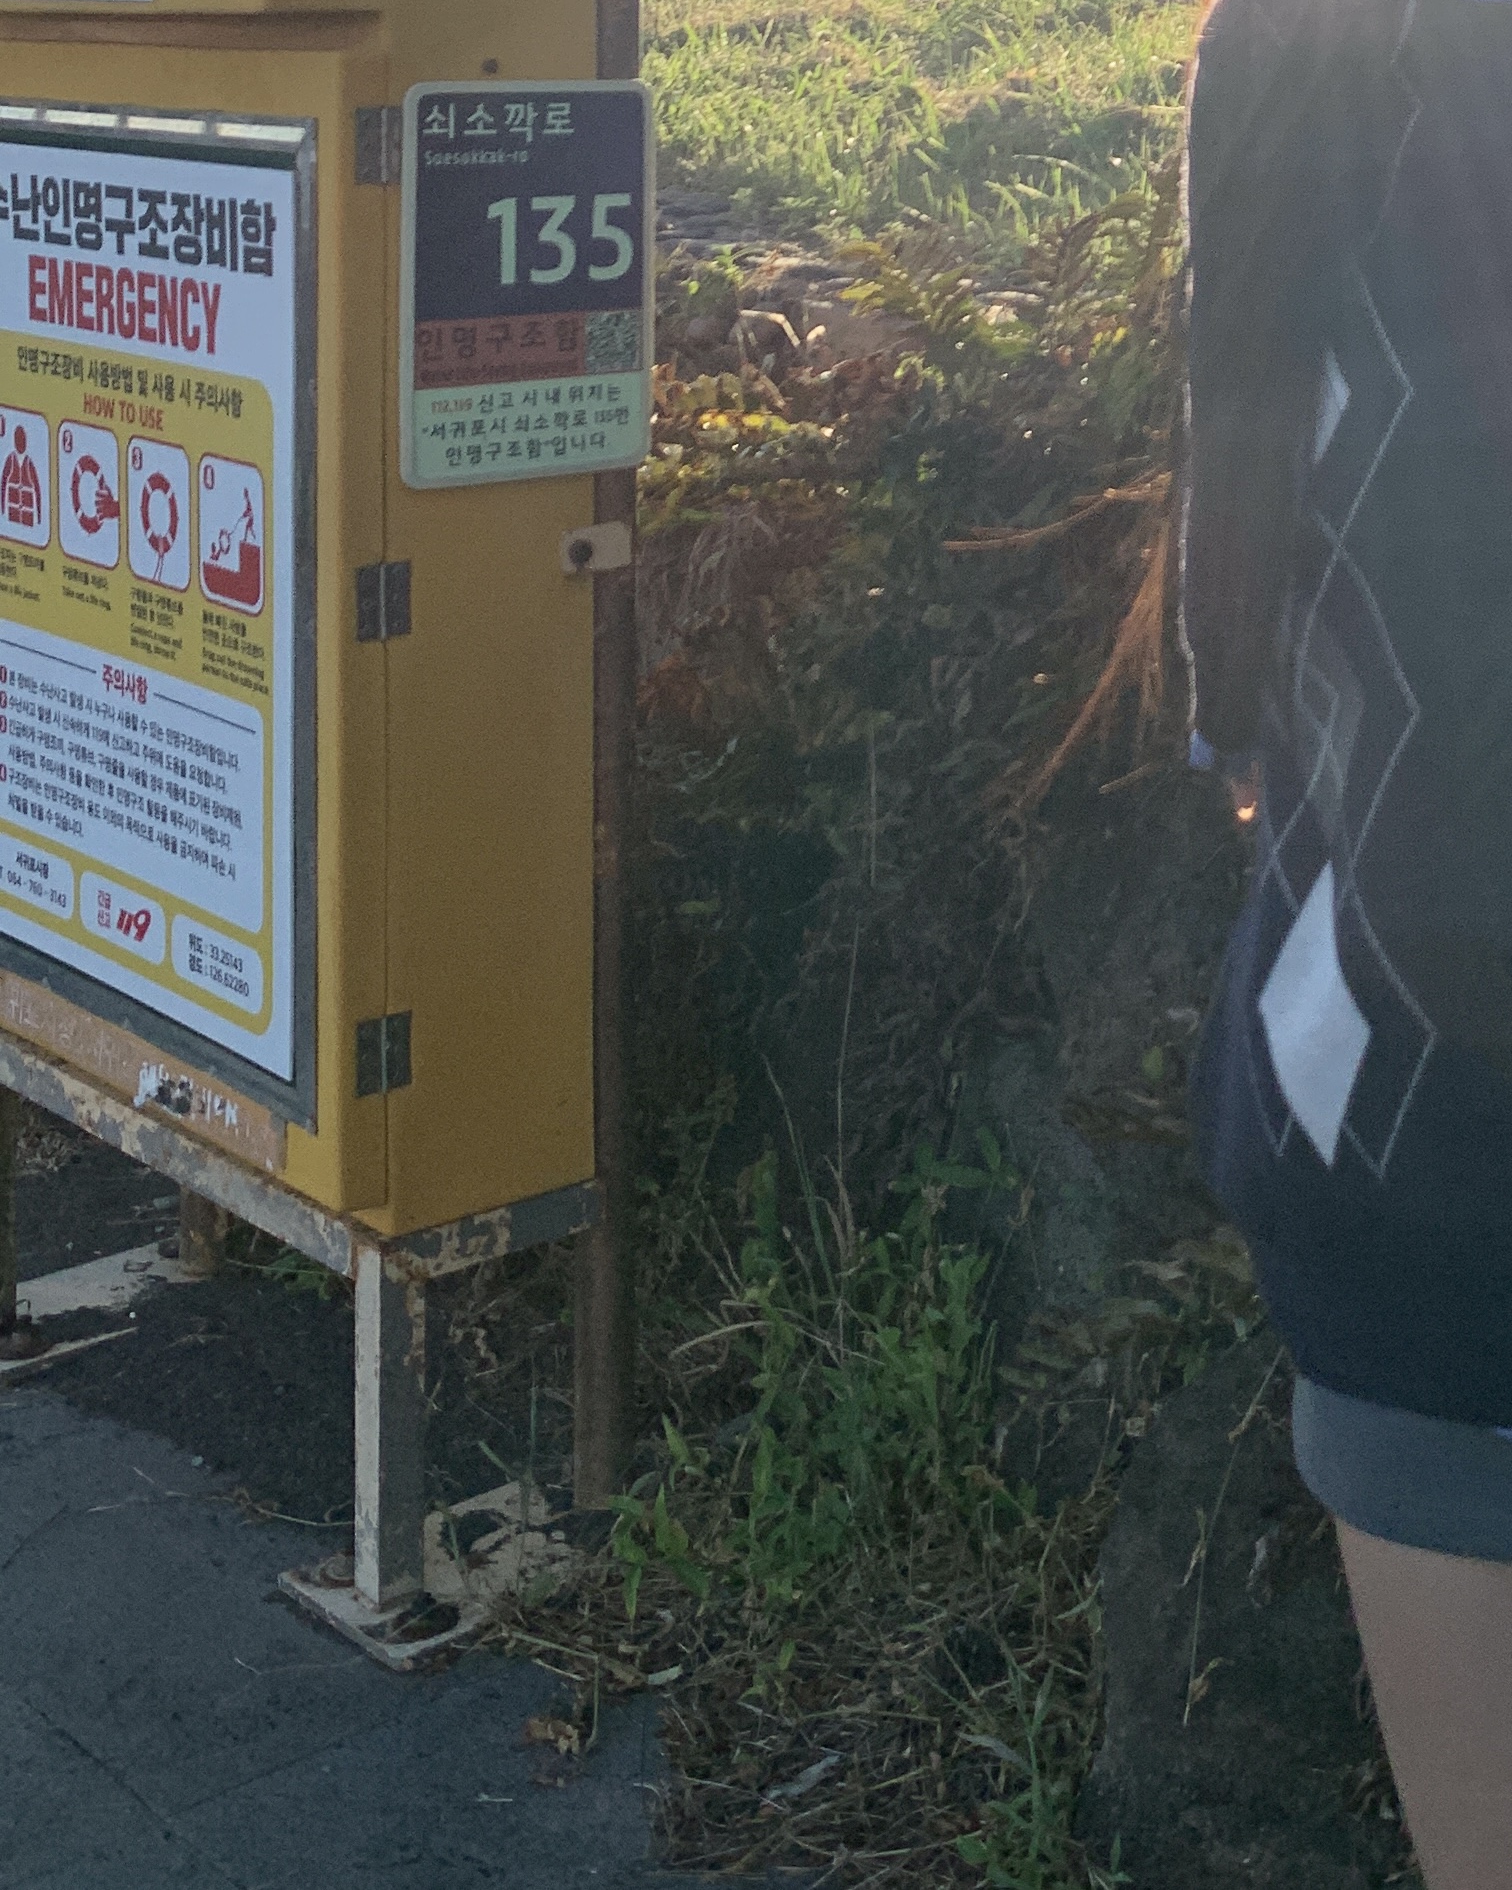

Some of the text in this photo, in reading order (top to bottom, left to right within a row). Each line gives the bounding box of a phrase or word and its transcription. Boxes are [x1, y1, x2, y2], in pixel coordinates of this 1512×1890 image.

[422, 102, 575, 142] 쇠소깍로
[487, 192, 634, 285] 135
[28, 254, 222, 355] EMERGENCY
[415, 316, 578, 361] 인명구조함
[17, 346, 243, 419] 인명구조장비 사용방법 및 사용 시 주의사항
[479, 392, 515, 415] 신고
[83, 392, 164, 431] HOW TO USE
[18, 672, 38, 695] 장비는
[40, 681, 68, 704] 수난사고
[70, 691, 84, 711] 발생
[94, 700, 115, 723] 누구나
[117, 710, 138, 731] 사용할
[141, 719, 148, 735] 수
[102, 663, 148, 704] 주의사항
[9, 695, 36, 717] 수난사고
[165, 754, 187, 778] 도움을
[116, 908, 151, 942] 119
